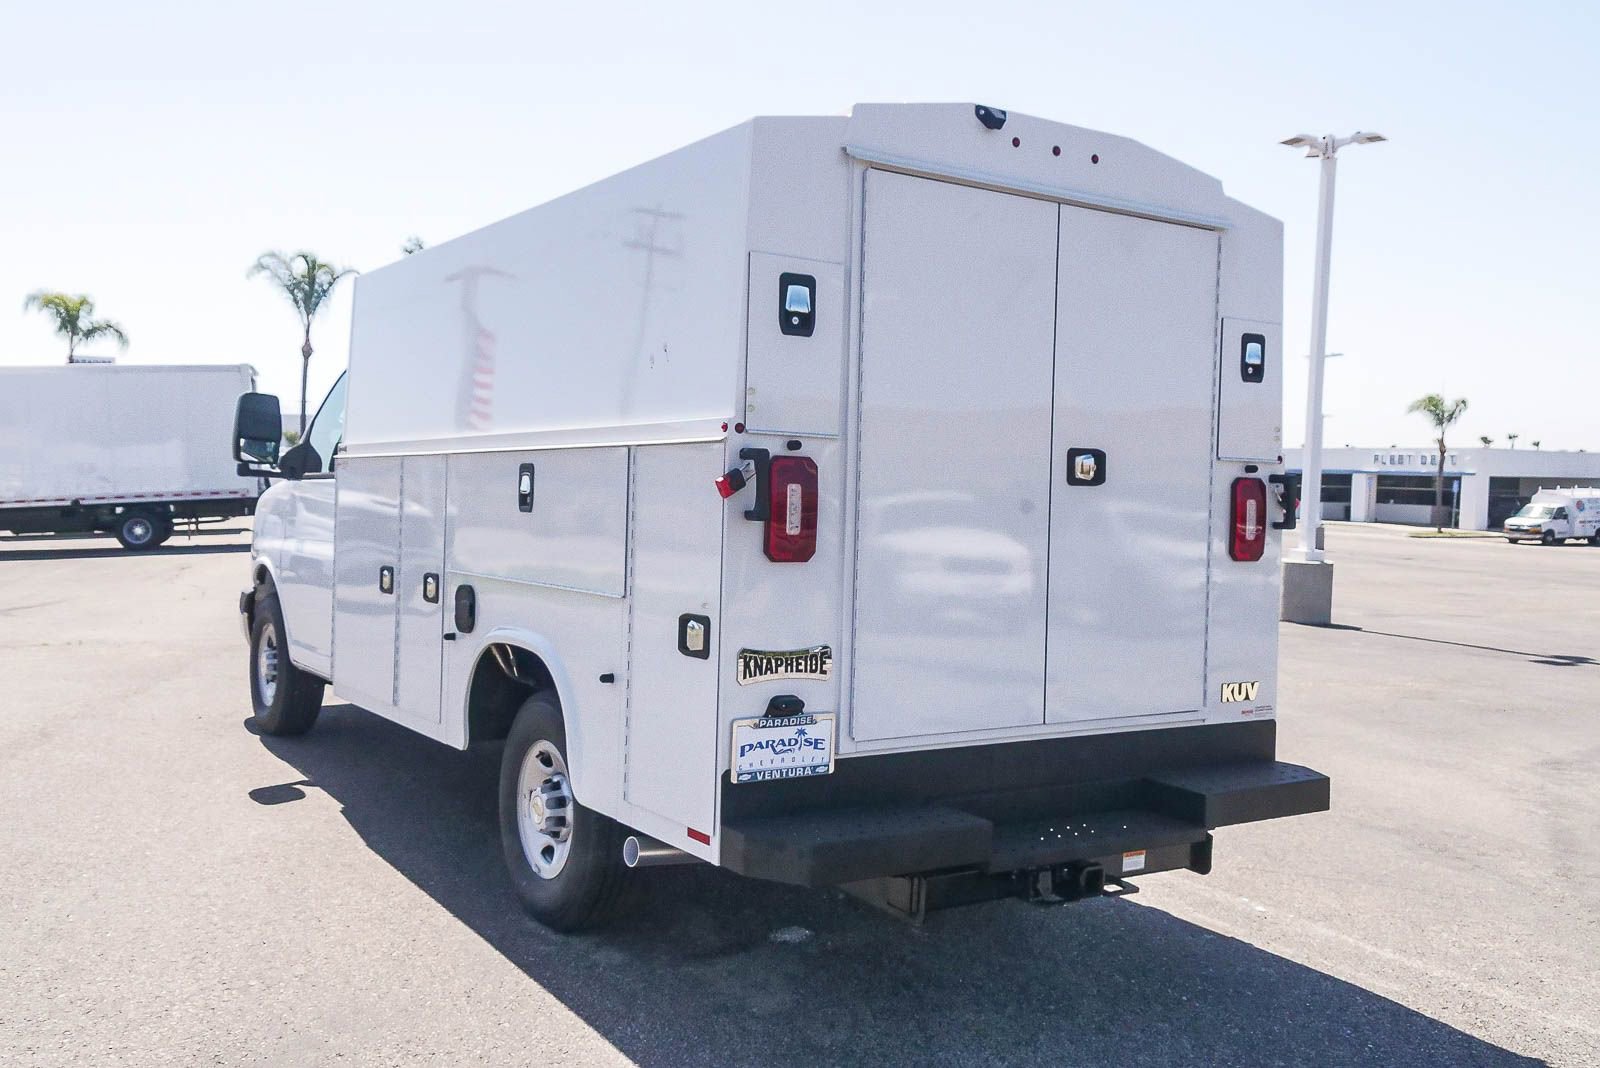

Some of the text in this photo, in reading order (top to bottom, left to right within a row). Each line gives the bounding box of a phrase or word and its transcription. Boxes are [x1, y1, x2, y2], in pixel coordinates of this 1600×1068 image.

[1420, 454, 1457, 466] DET
[742, 649, 829, 680] KNAPHEIDE
[1220, 680, 1259, 703] KUV
[759, 715, 813, 728] PARADISE
[739, 732, 826, 758] PARADISE
[738, 756, 825, 771] CHEVROLET
[756, 766, 813, 781] VENTURA
